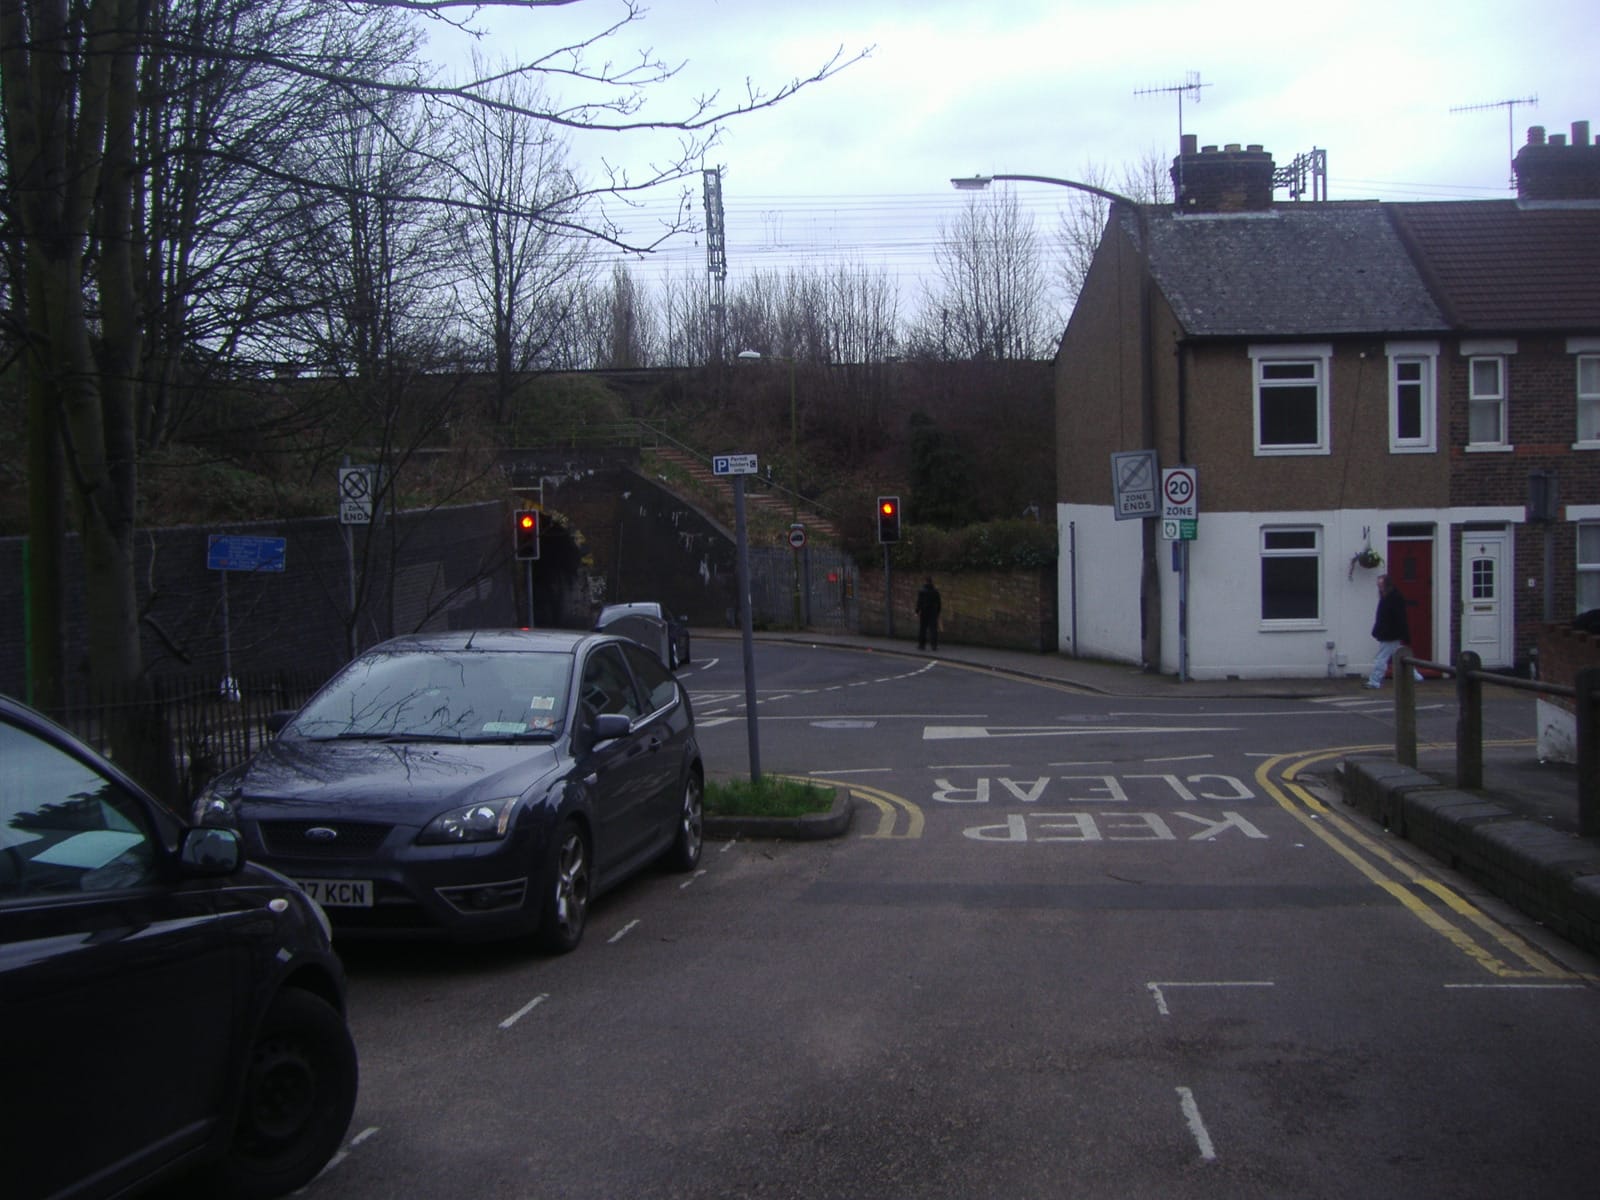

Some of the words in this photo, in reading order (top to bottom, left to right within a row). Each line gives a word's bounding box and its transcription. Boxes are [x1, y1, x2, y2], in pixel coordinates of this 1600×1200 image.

[717, 459, 727, 471] P
[1169, 481, 1190, 495] 20
[1125, 493, 1148, 502] ZONE
[1123, 501, 1151, 511] ENDS
[1166, 507, 1193, 516] ZONE
[932, 774, 1256, 802] CLEAR
[962, 811, 1269, 842] KEEP
[324, 882, 365, 904] KCN
